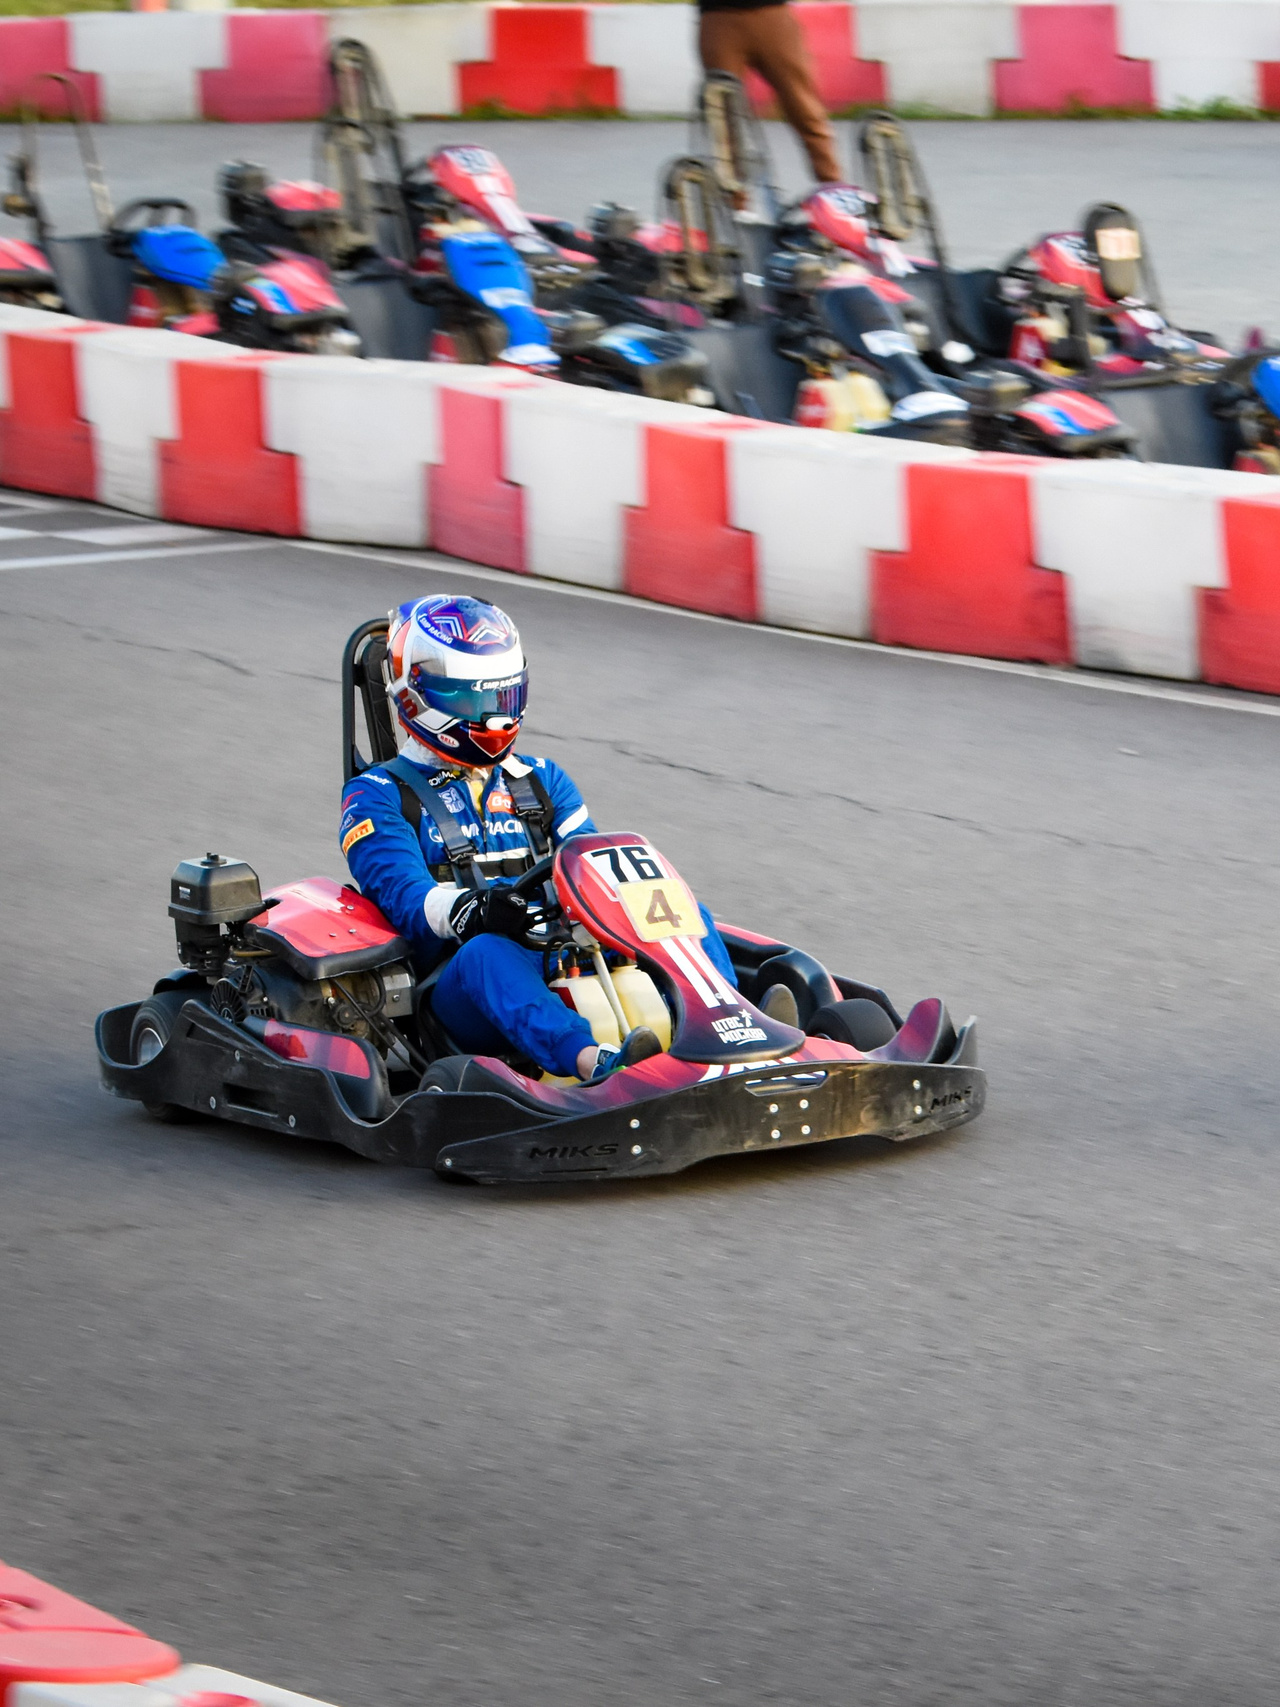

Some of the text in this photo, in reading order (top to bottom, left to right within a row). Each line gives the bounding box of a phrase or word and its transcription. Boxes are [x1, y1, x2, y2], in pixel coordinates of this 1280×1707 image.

[440, 735, 456, 746] BELL
[590, 846, 665, 883] 76
[645, 888, 683, 929] 4
[528, 1143, 619, 1159] MIKS
